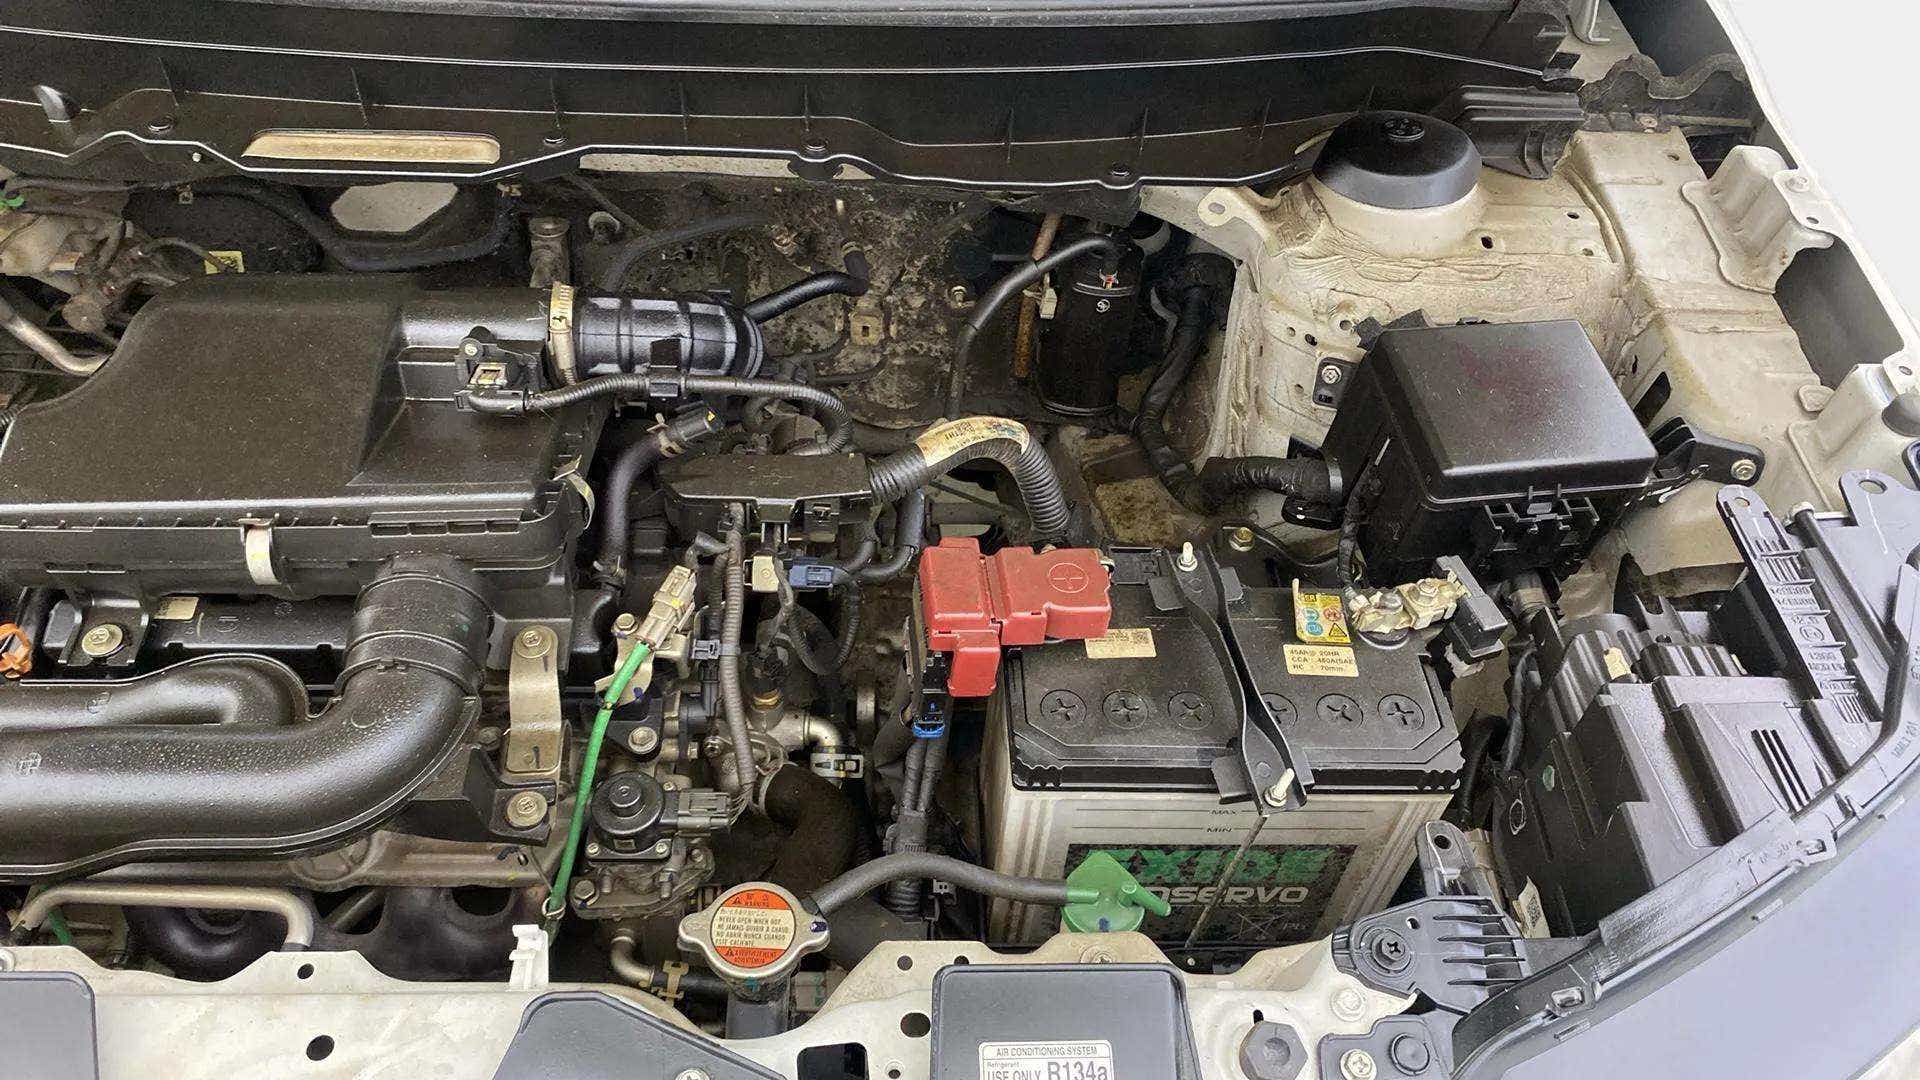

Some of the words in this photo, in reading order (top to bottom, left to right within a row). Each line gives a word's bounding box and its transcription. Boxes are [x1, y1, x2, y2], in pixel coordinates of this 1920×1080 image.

[996, 1047, 1009, 1057] AIR
[1010, 1046, 1065, 1057] CONDITIONING
[1067, 1045, 1098, 1056] SYSTEM
[986, 1070, 1009, 1080] USE
[1012, 1070, 1041, 1080] ONLY
